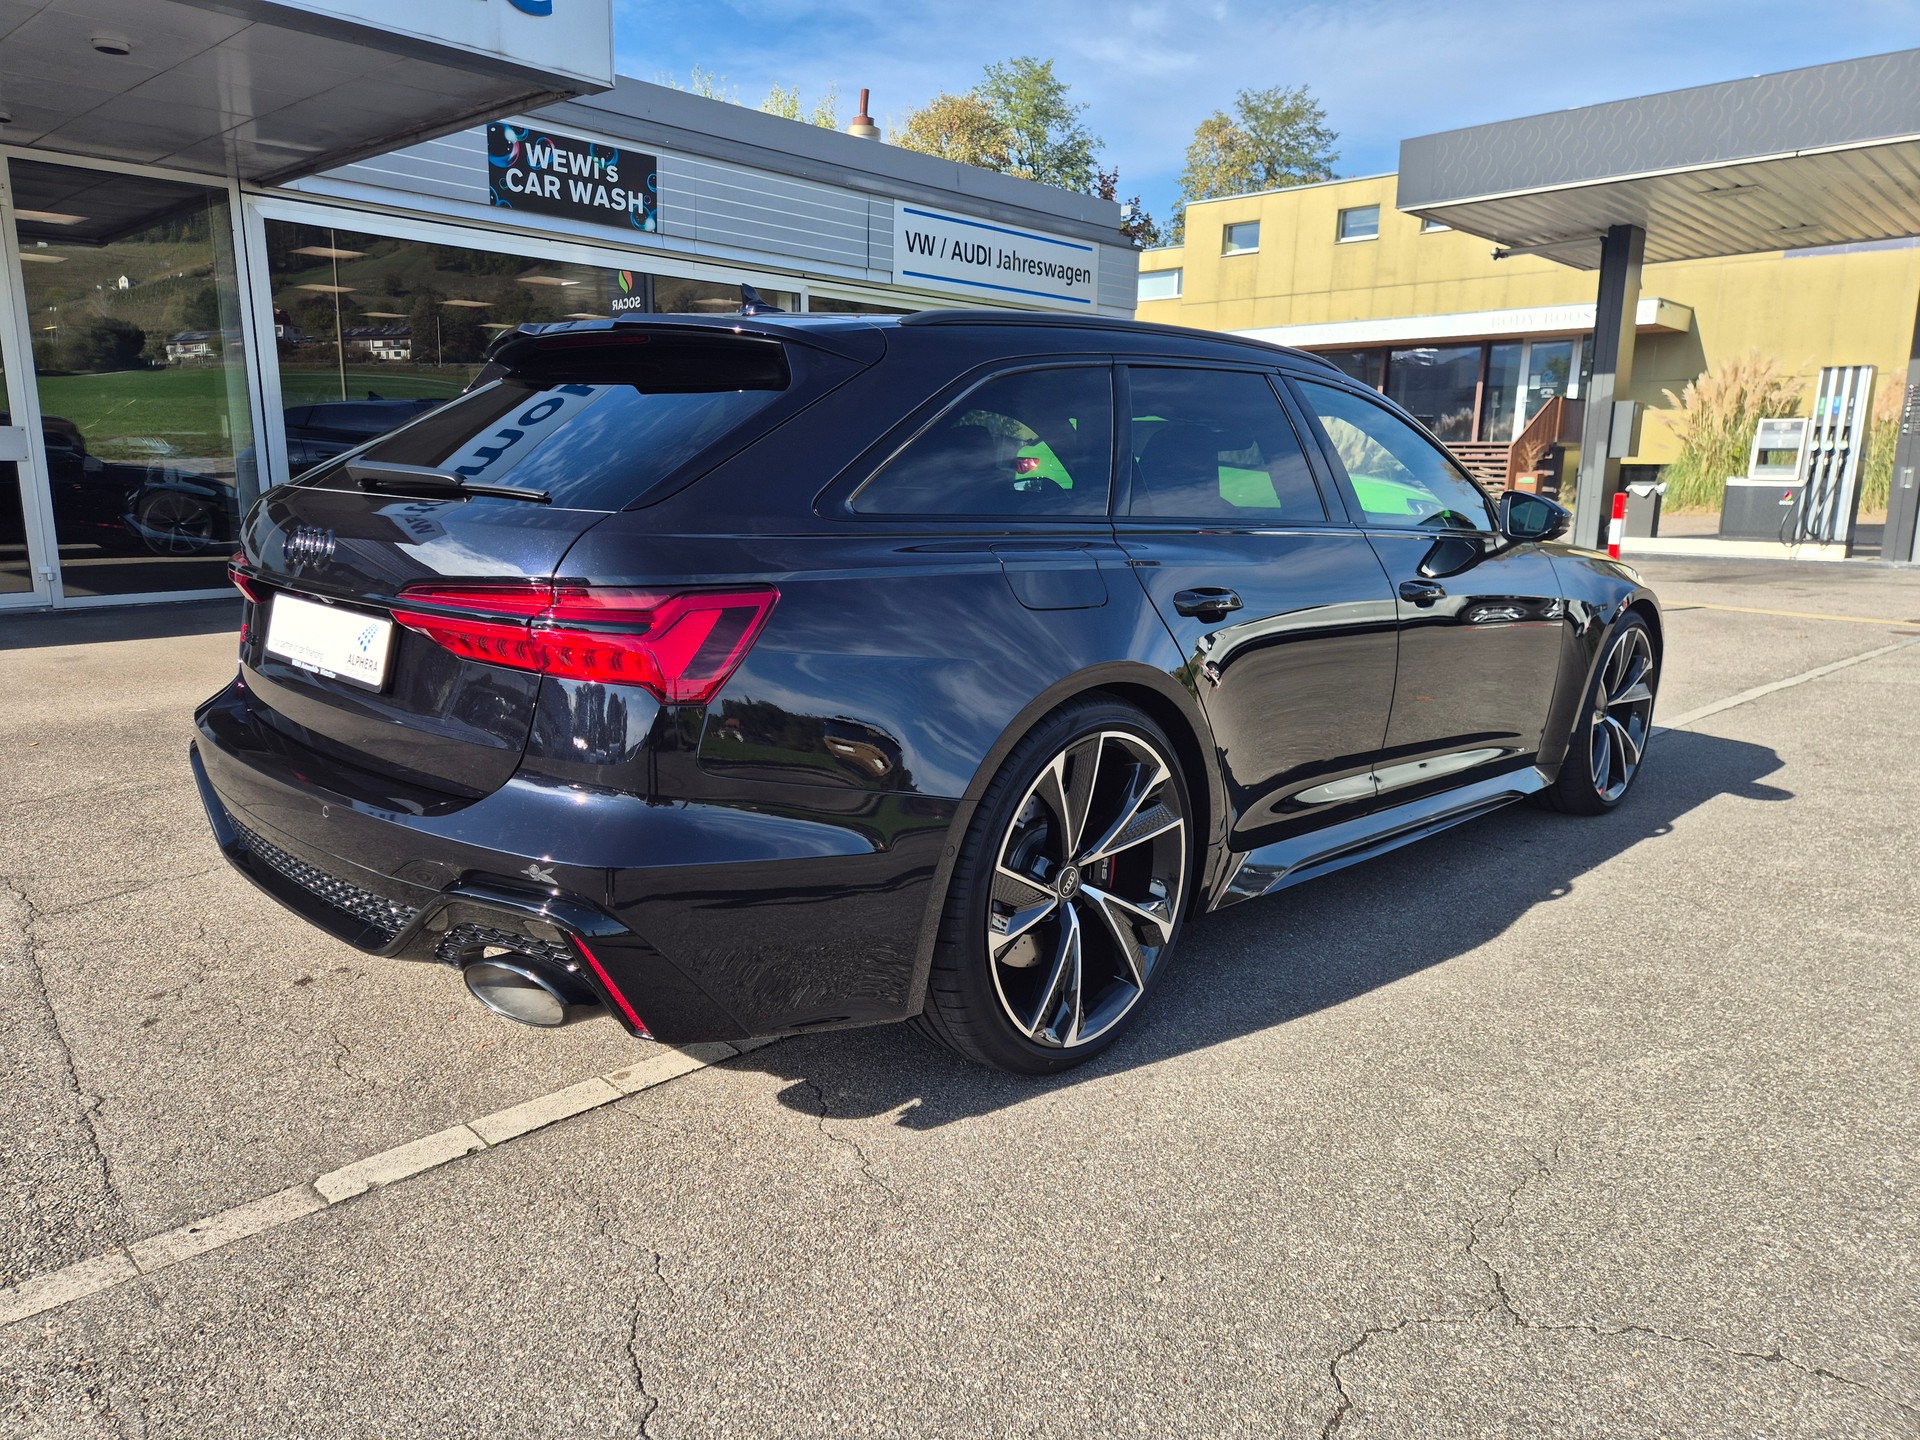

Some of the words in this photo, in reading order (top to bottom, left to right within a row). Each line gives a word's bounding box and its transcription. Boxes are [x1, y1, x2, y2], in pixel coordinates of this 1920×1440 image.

[525, 142, 619, 183] WEWi's
[506, 168, 561, 200] CAR
[569, 179, 644, 214] WASH
[905, 230, 936, 257] VW
[940, 237, 947, 259] /
[951, 240, 992, 267] AUDI
[996, 249, 1091, 286] Jahreswagen
[1491, 314, 1537, 328] BODY
[1544, 311, 1592, 324] BOOS
[347, 654, 378, 672] ALPHERA
